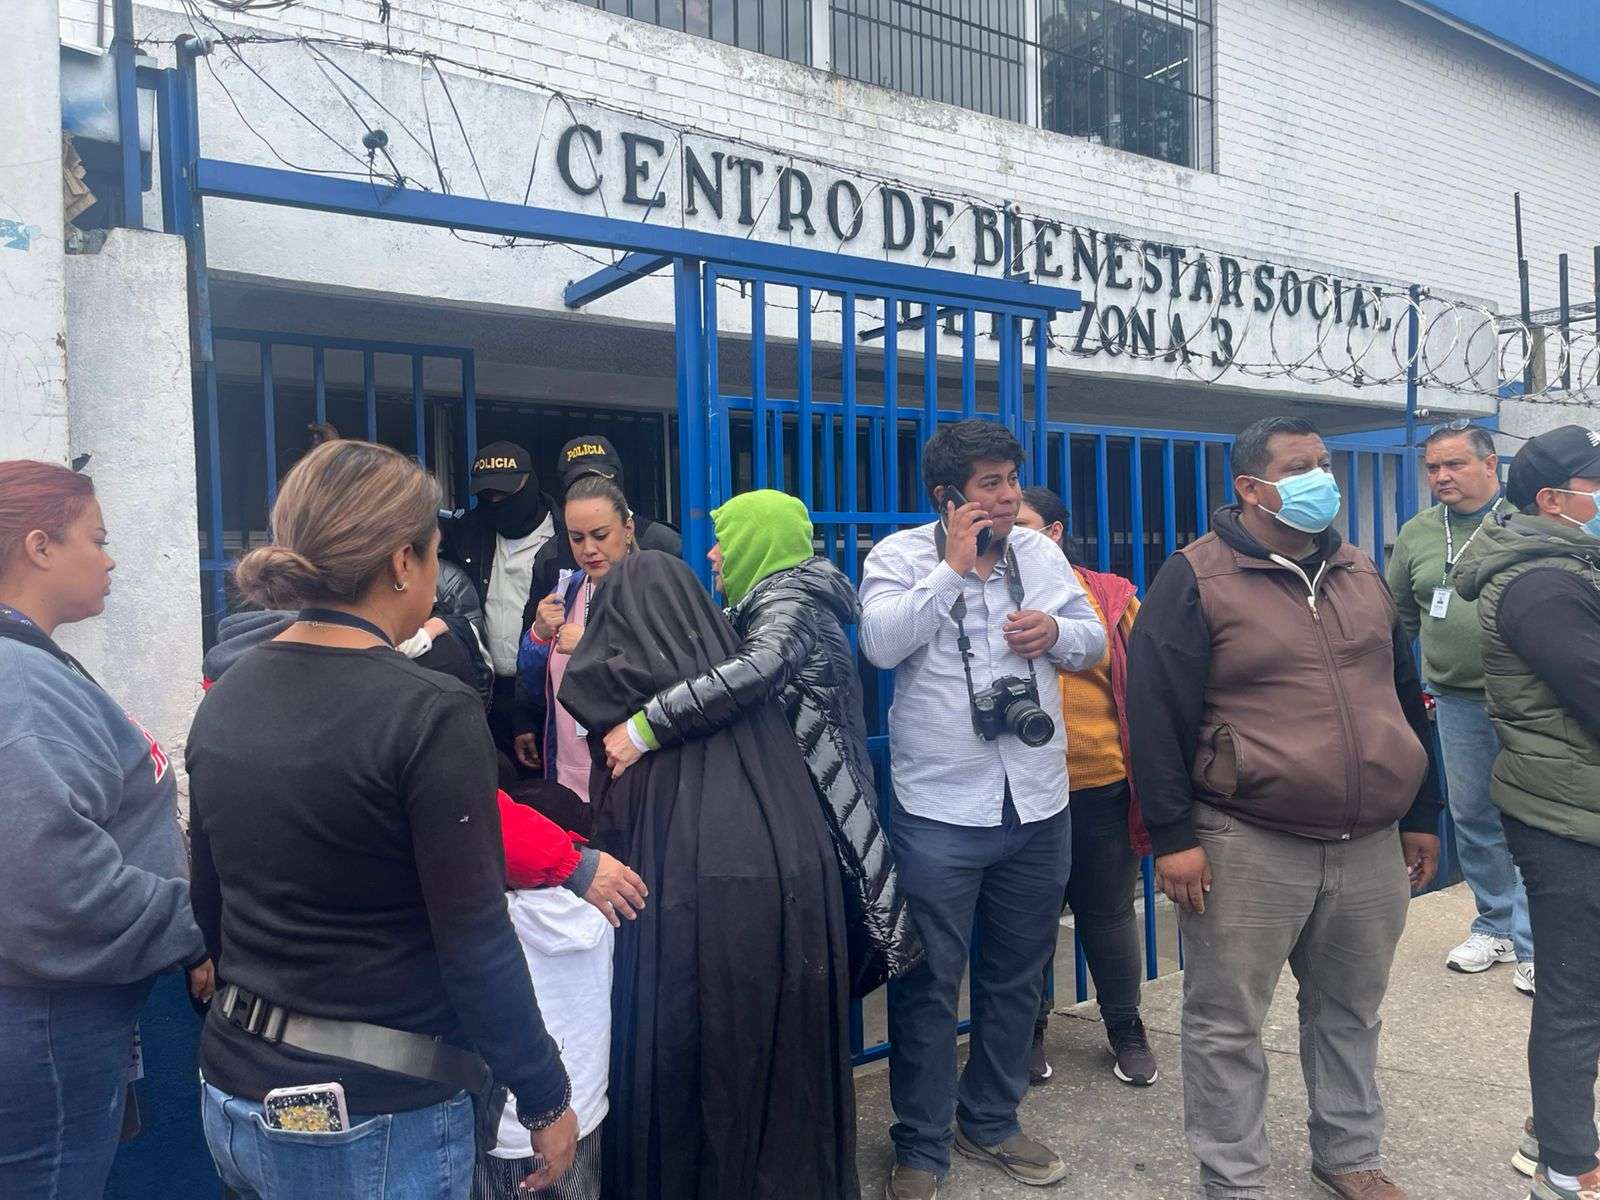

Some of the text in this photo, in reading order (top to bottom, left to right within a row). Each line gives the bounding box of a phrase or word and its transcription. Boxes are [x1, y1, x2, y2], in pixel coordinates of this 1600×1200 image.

[556, 124, 1392, 332] CENTRO DE BIENESTAR SOCIAL
[1071, 301, 1192, 364] ZONA
[1211, 316, 1233, 367] 3
[474, 457, 517, 472] POLICIA
[567, 444, 606, 462] POLICIA
